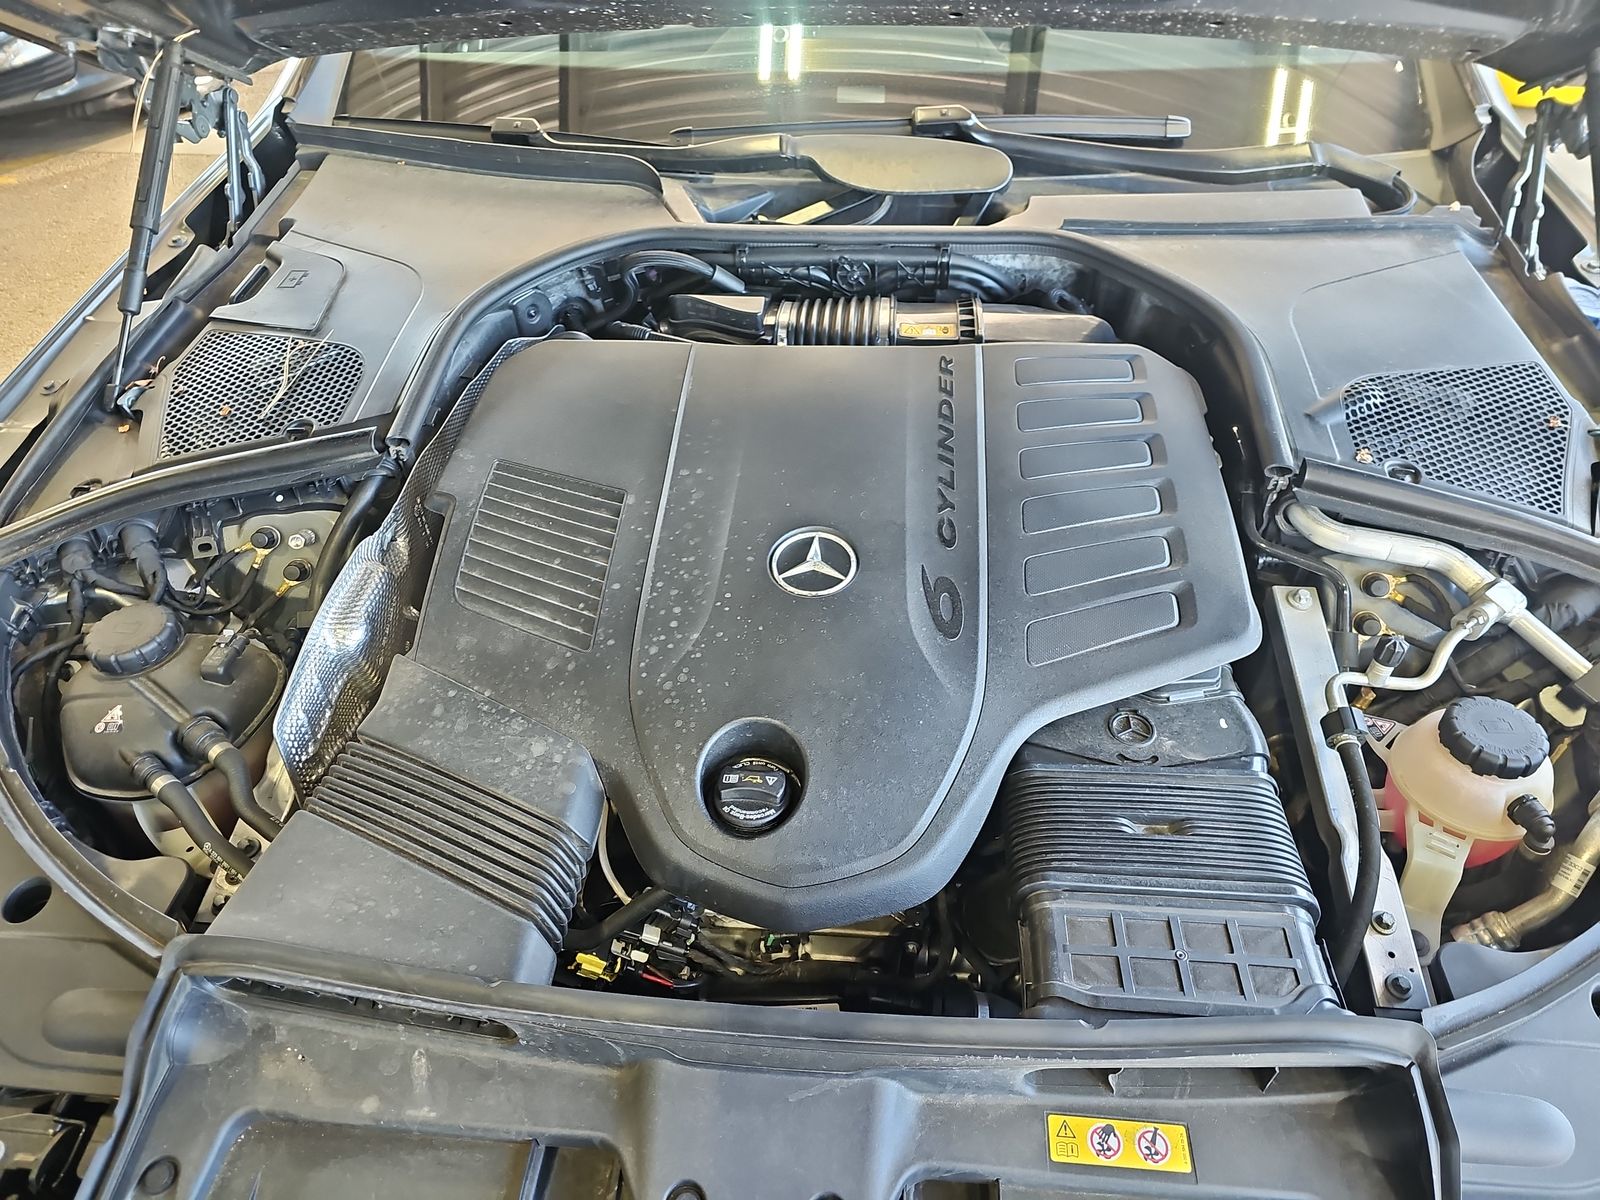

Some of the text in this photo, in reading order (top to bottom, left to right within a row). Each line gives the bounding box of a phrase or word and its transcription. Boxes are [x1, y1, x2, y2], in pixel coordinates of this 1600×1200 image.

[921, 355, 965, 642] 6 CYLINDER
[728, 805, 769, 814] recommended
[729, 809, 776, 820] Mercedes-Benz
